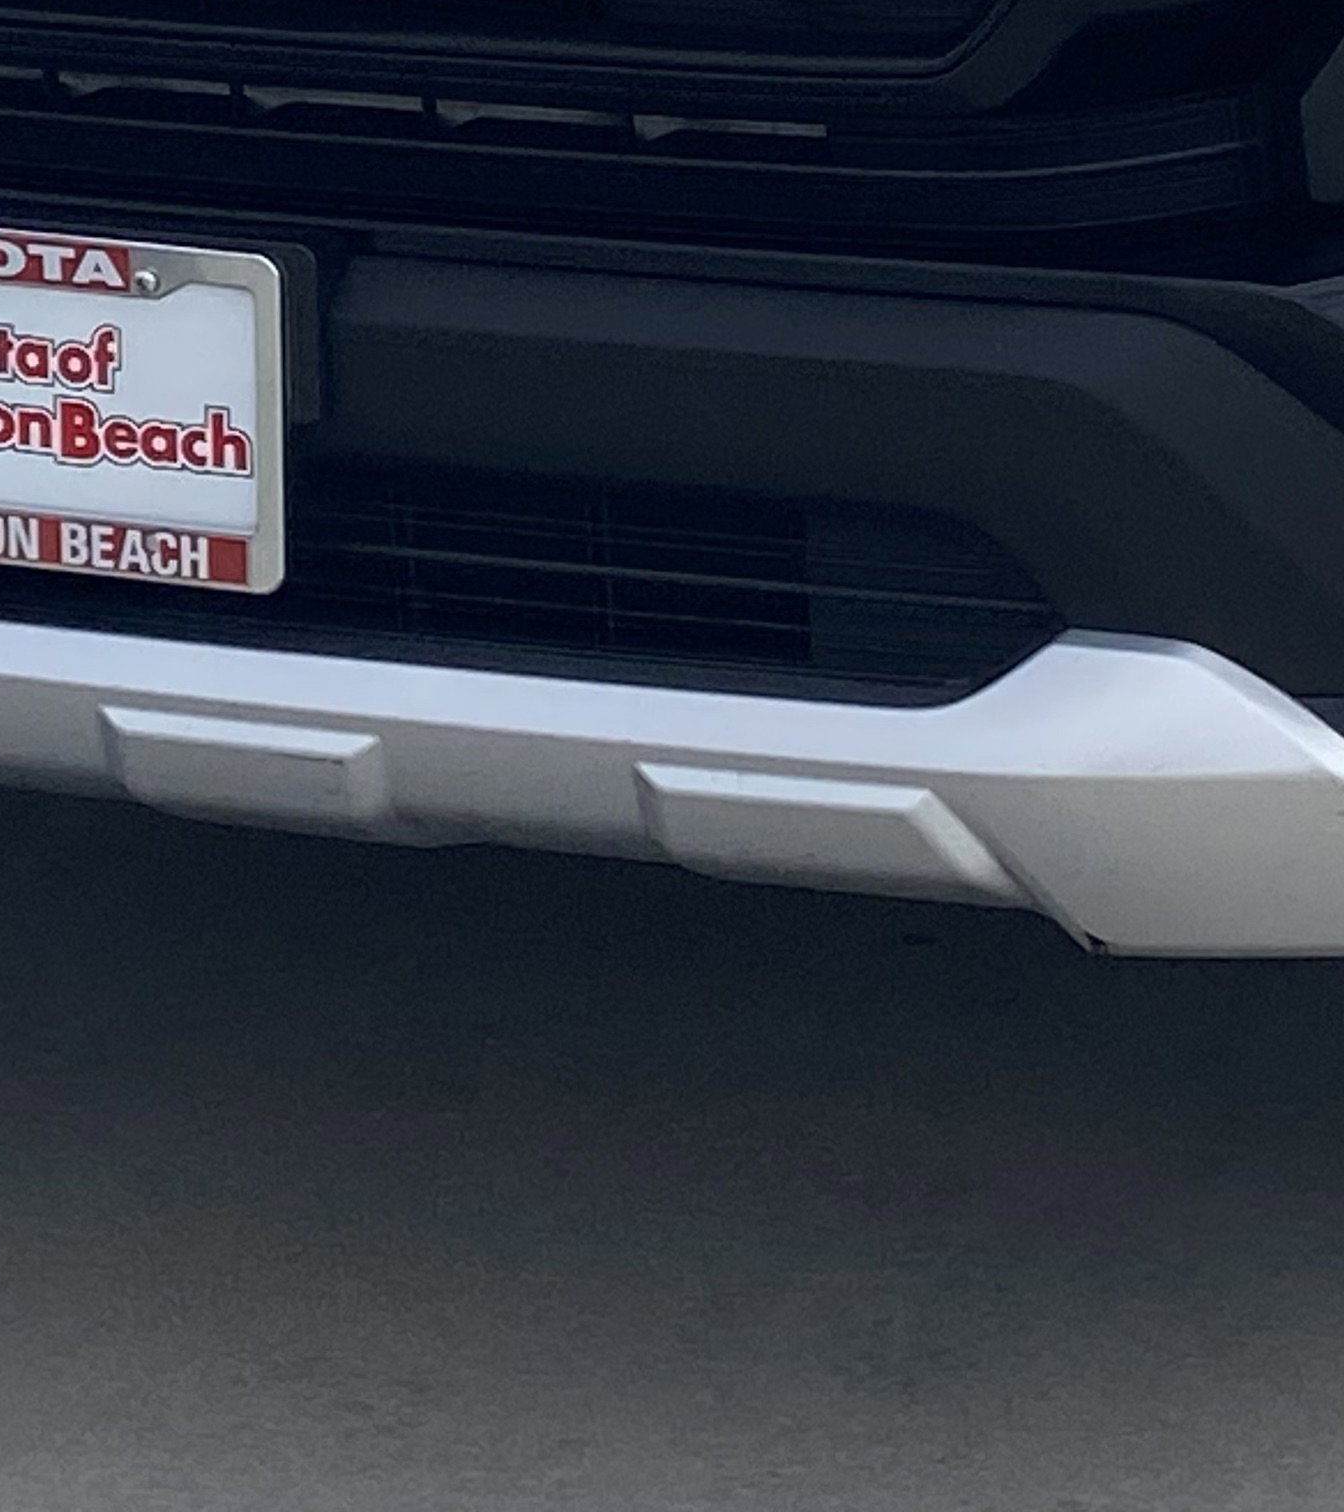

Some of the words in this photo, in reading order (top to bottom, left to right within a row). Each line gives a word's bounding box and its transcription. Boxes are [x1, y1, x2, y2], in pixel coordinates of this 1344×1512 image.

[56, 325, 118, 386] of
[57, 401, 249, 472] Beach
[60, 522, 210, 581] BEACH
